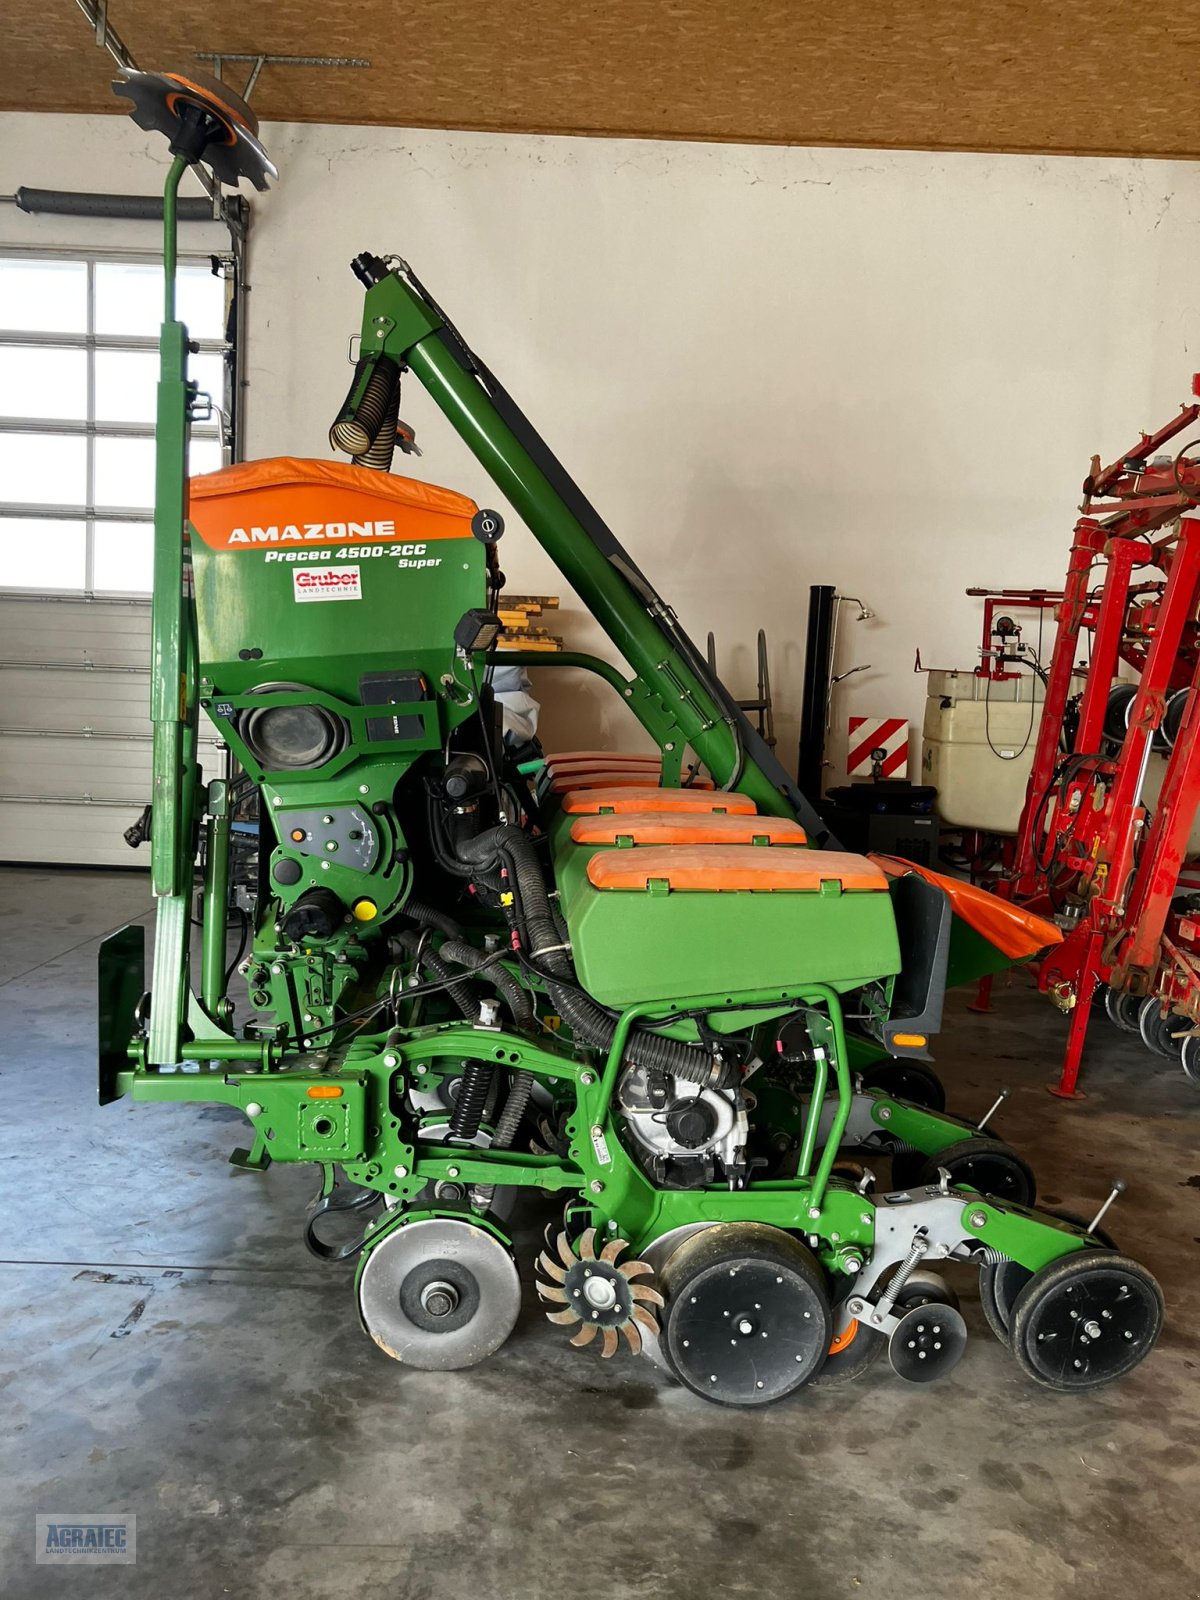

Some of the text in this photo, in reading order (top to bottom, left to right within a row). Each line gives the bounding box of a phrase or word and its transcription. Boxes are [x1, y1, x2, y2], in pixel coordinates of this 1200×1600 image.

[228, 521, 395, 544] AMAZONE
[265, 544, 427, 563] Precea 4500-2CC
[398, 557, 442, 569] Super
[296, 571, 358, 587] Gruber
[297, 586, 358, 594] LANDTECHNIK
